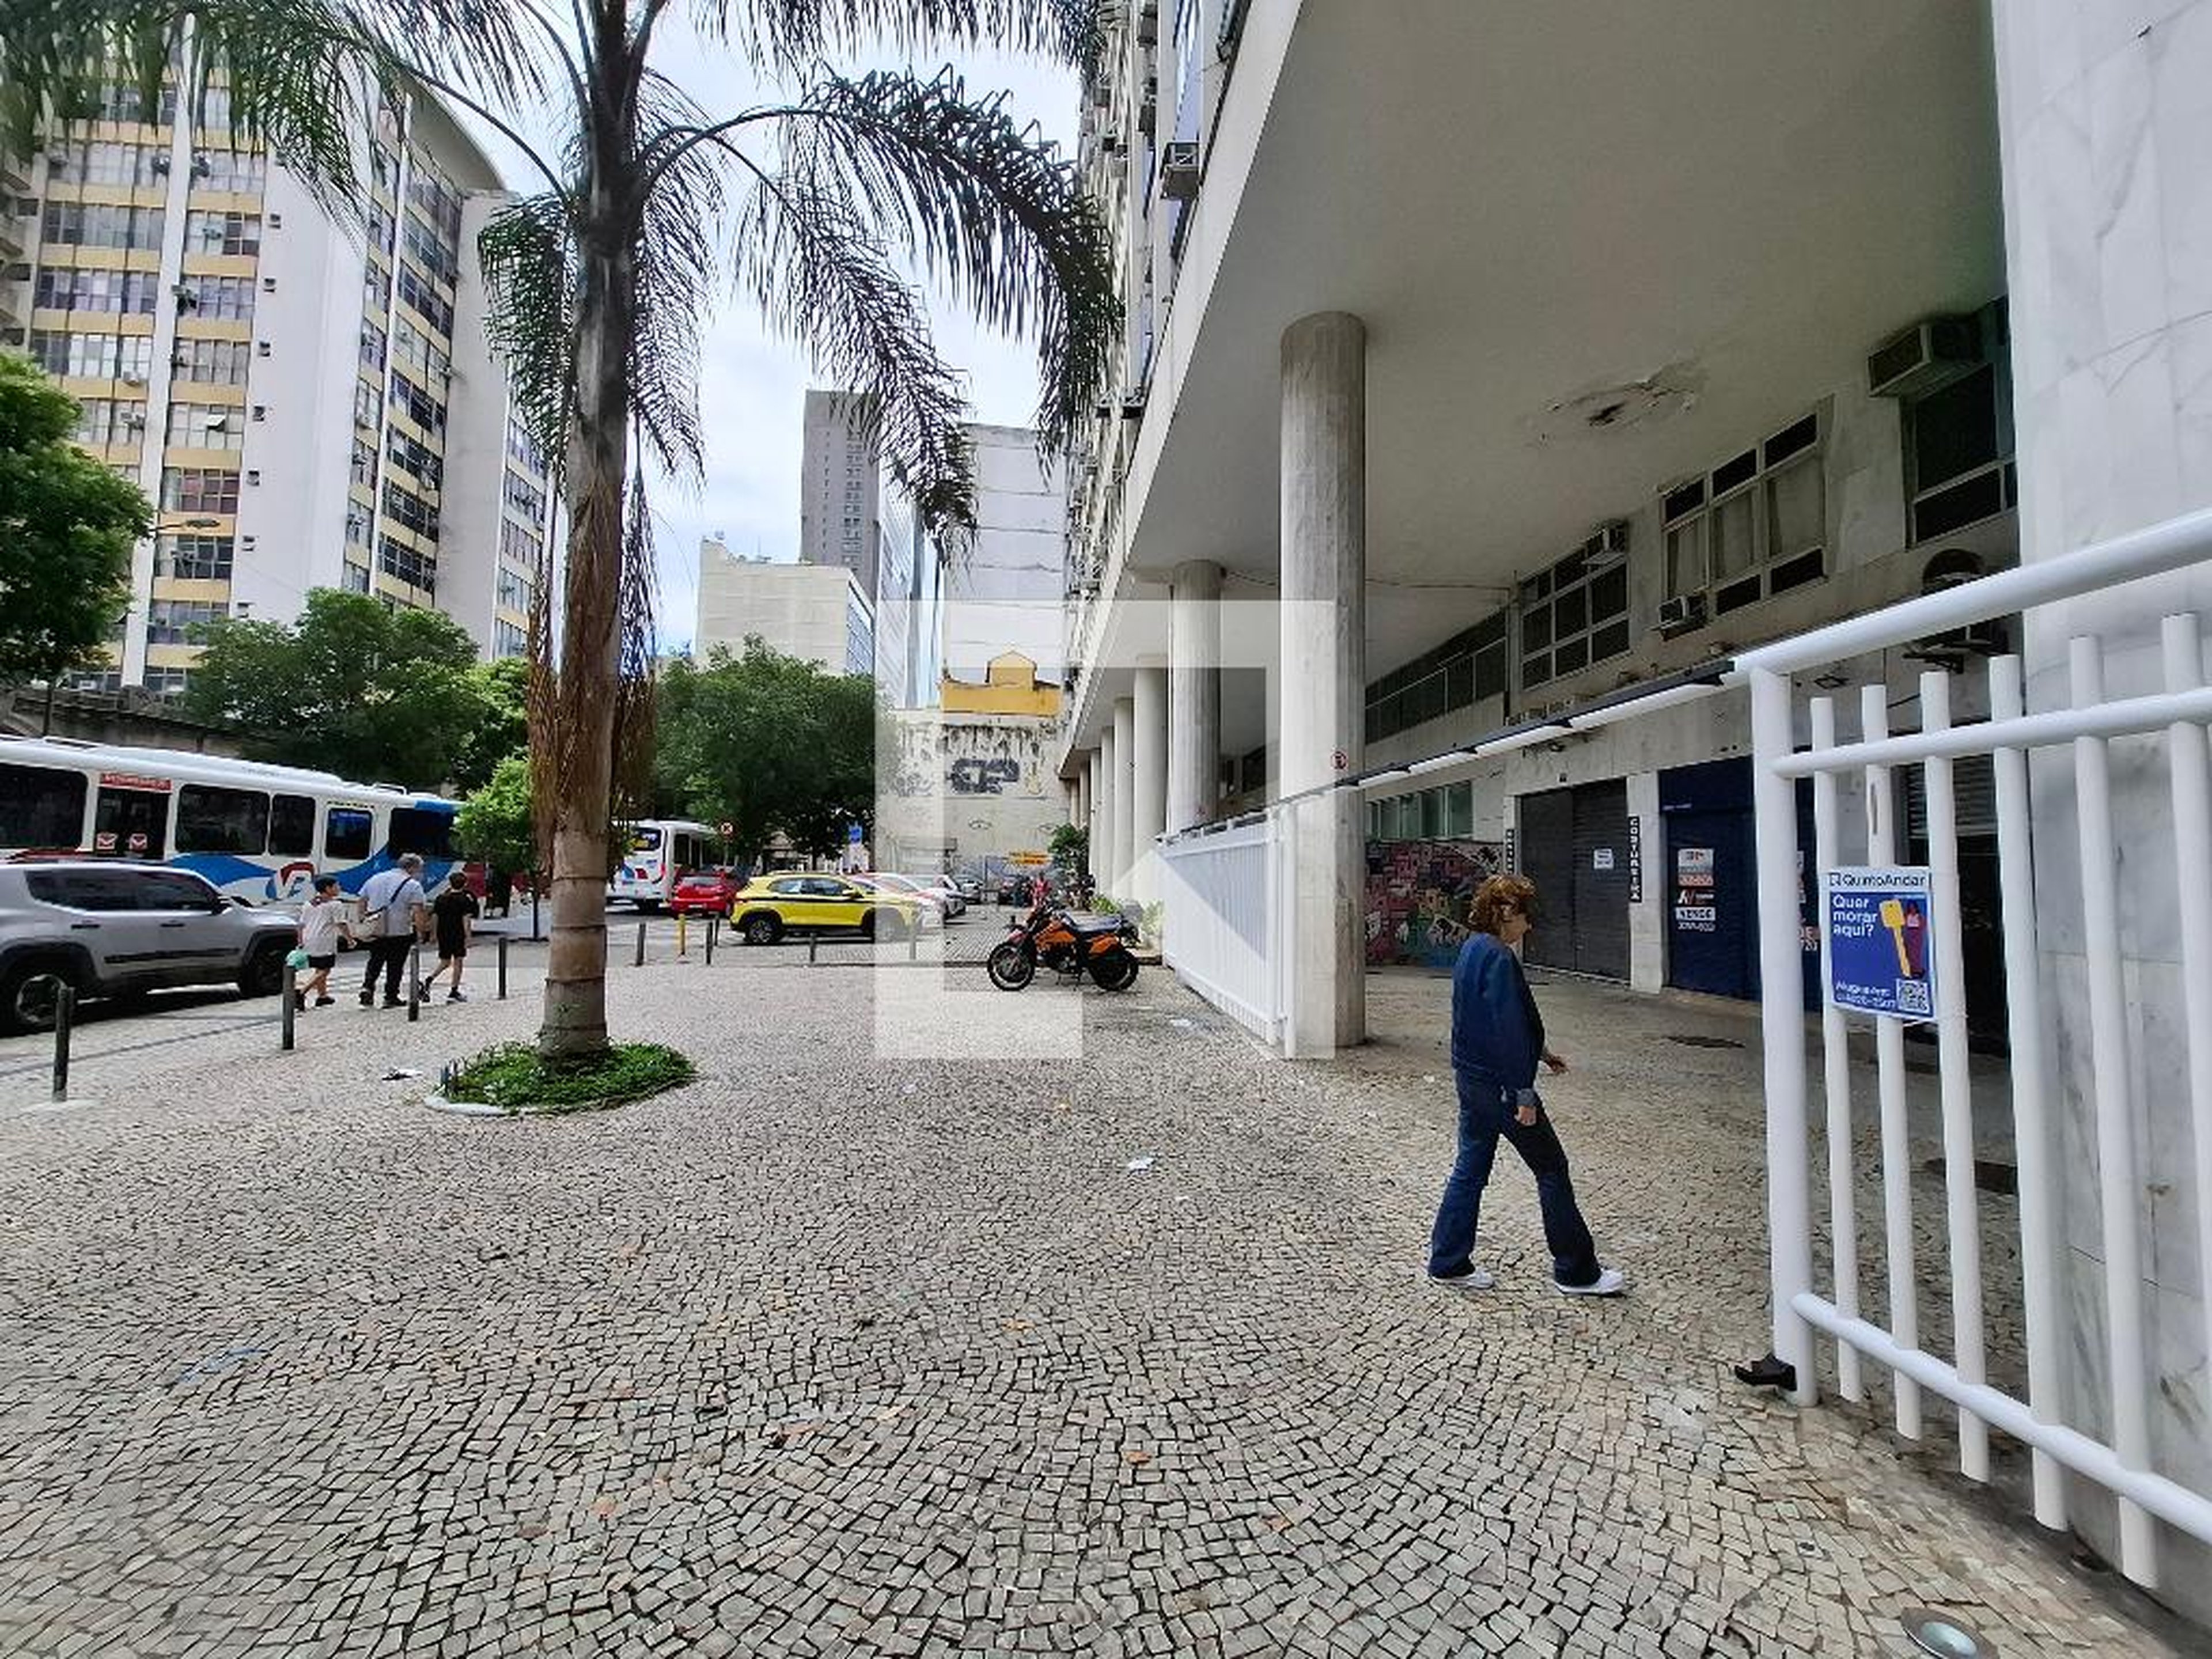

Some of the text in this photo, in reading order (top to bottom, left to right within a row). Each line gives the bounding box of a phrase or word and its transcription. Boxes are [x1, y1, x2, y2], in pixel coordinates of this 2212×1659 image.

[1833, 894, 1869, 908] Quer
[1833, 911, 1878, 923] morar
[1833, 923, 1874, 938] aqui?
